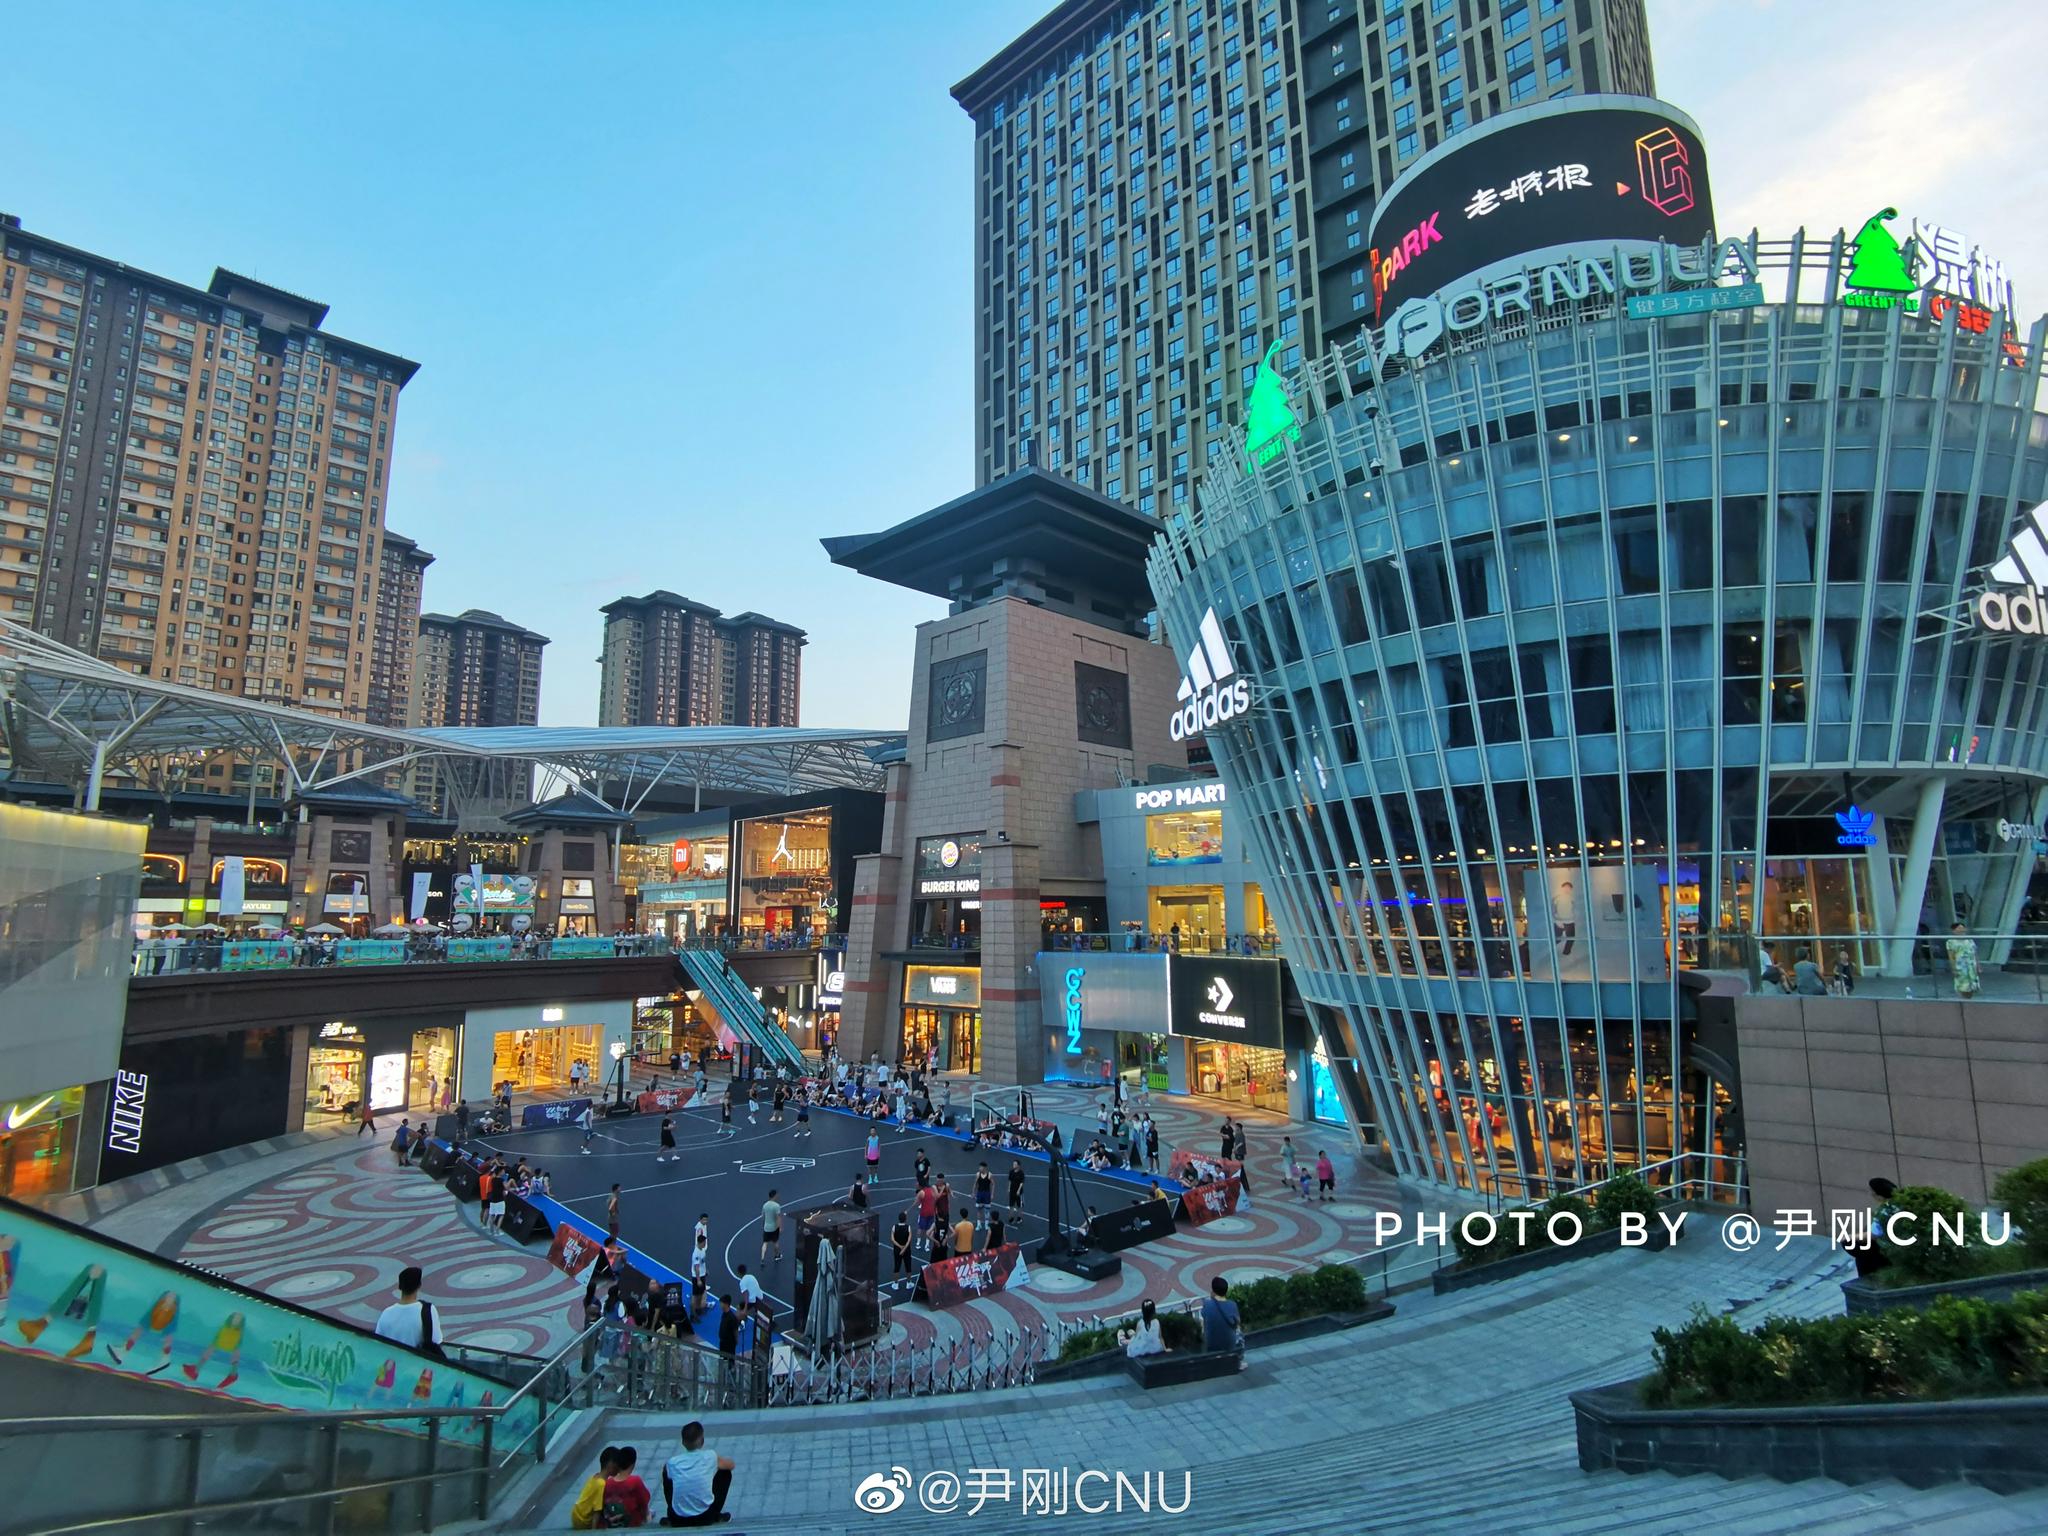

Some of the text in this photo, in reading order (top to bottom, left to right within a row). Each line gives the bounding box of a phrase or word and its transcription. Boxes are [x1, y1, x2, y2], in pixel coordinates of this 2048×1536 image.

[1382, 211, 1444, 291] PARK
[1382, 236, 1760, 358] FORMULA
[1845, 293, 1919, 312] GREENTEE
[1170, 679, 1250, 742] adidas
[1135, 789, 1173, 809] POP
[1837, 833, 1877, 846] adidas
[921, 879, 980, 894] BURGER KING
[930, 977, 957, 995] VANS
[1199, 1011, 1246, 1029] CONVERSE
[109, 1069, 148, 1153] NIKE
